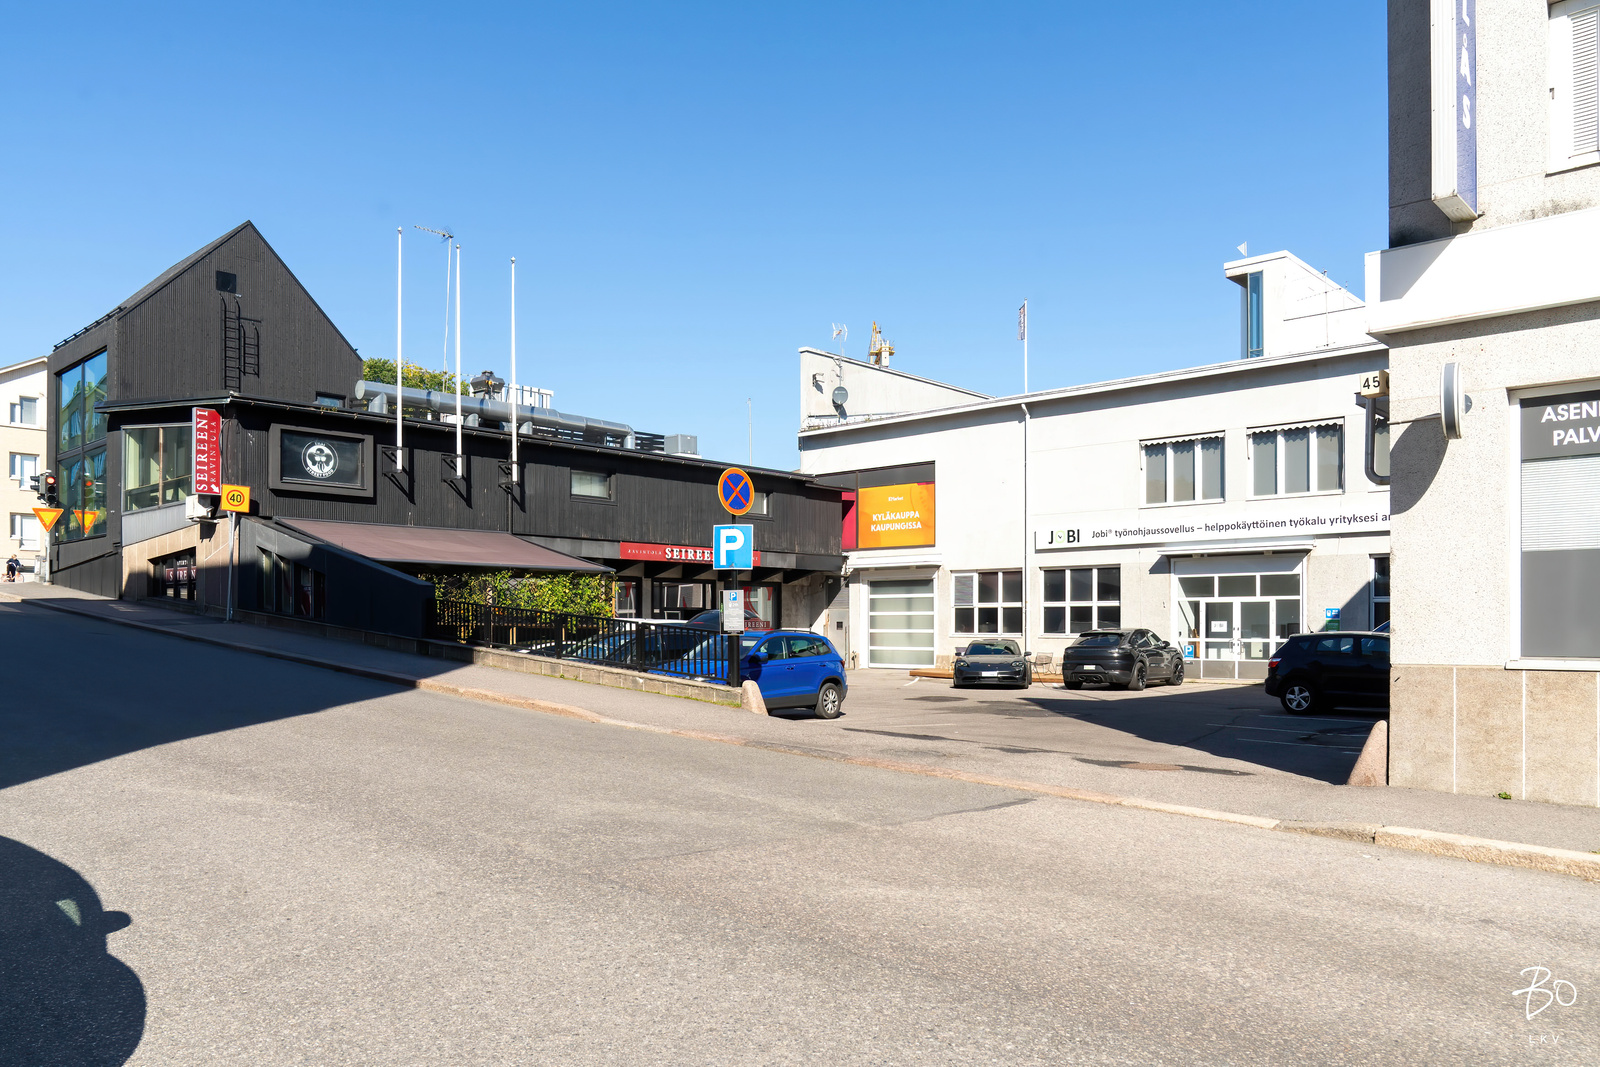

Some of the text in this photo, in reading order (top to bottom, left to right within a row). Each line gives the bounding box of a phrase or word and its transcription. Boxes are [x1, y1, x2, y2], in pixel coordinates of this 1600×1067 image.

[1362, 375, 1381, 390] 45
[1540, 400, 1600, 423] ASEN
[196, 410, 208, 491] SEIREENI
[229, 493, 242, 503] 40
[872, 511, 920, 521] KYLÄKAUPPA
[870, 521, 922, 532] KAUPUNGISSA
[1114, 525, 1195, 538] työnohjaussovellus
[1204, 519, 1287, 532] helppokäyttöinen
[1289, 516, 1326, 528] työkalu
[1329, 513, 1378, 525] yrityksesi
[665, 547, 713, 561] SEIREE
[720, 528, 745, 566] P
